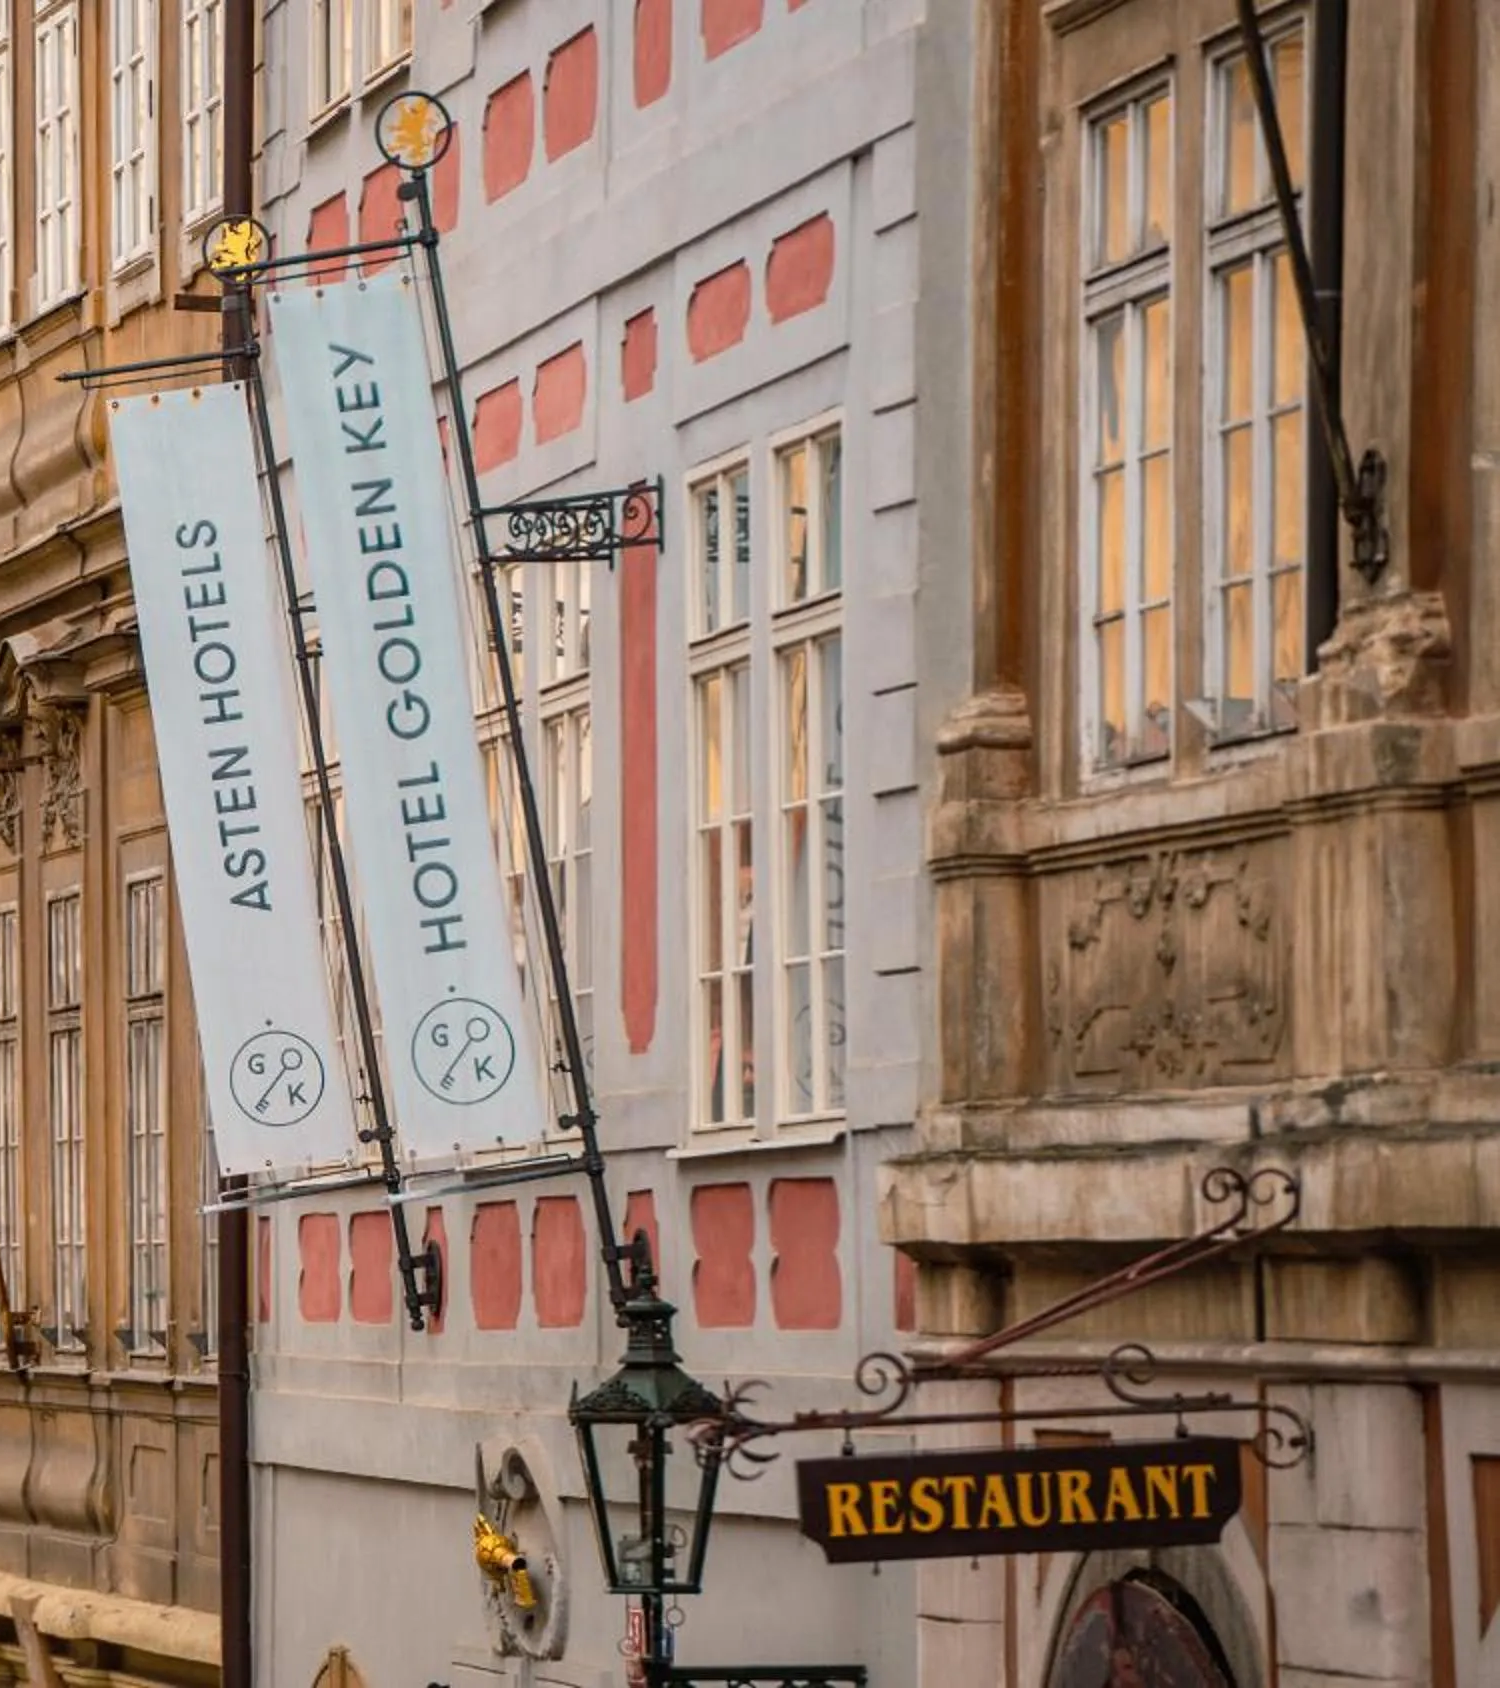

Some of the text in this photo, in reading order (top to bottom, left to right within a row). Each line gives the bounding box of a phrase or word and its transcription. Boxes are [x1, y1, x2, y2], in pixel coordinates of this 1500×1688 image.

[175, 519, 273, 912] ASTEN HOTELS
[328, 343, 468, 955] HOTEL GOLDEN KEY
[825, 1463, 1215, 1538] RESTAURANT
